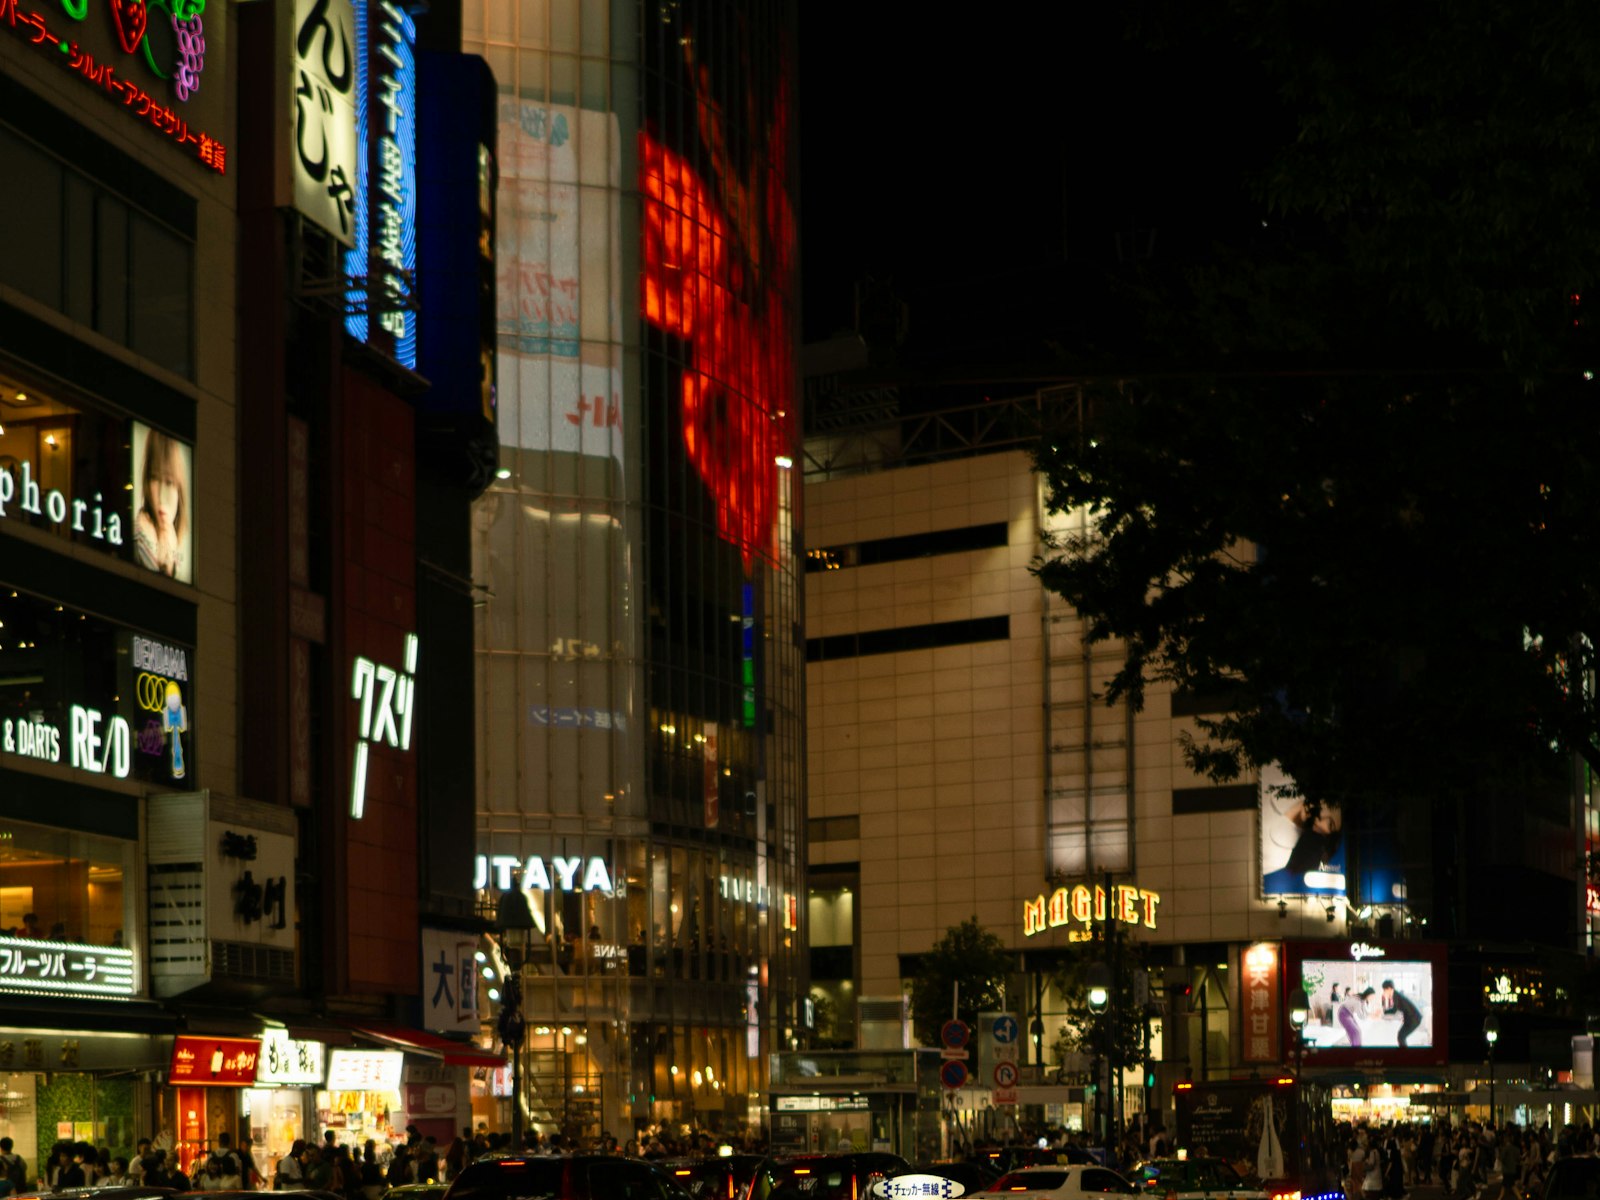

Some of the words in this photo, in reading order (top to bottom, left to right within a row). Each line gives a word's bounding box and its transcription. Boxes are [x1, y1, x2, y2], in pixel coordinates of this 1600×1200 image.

[4, 719, 15, 751] &
[18, 718, 60, 762] DARTS
[1024, 884, 1160, 937] MAGNET
[1490, 993, 1518, 1002] COFFEE
[894, 1183, 940, 1197] チェッカー無線
